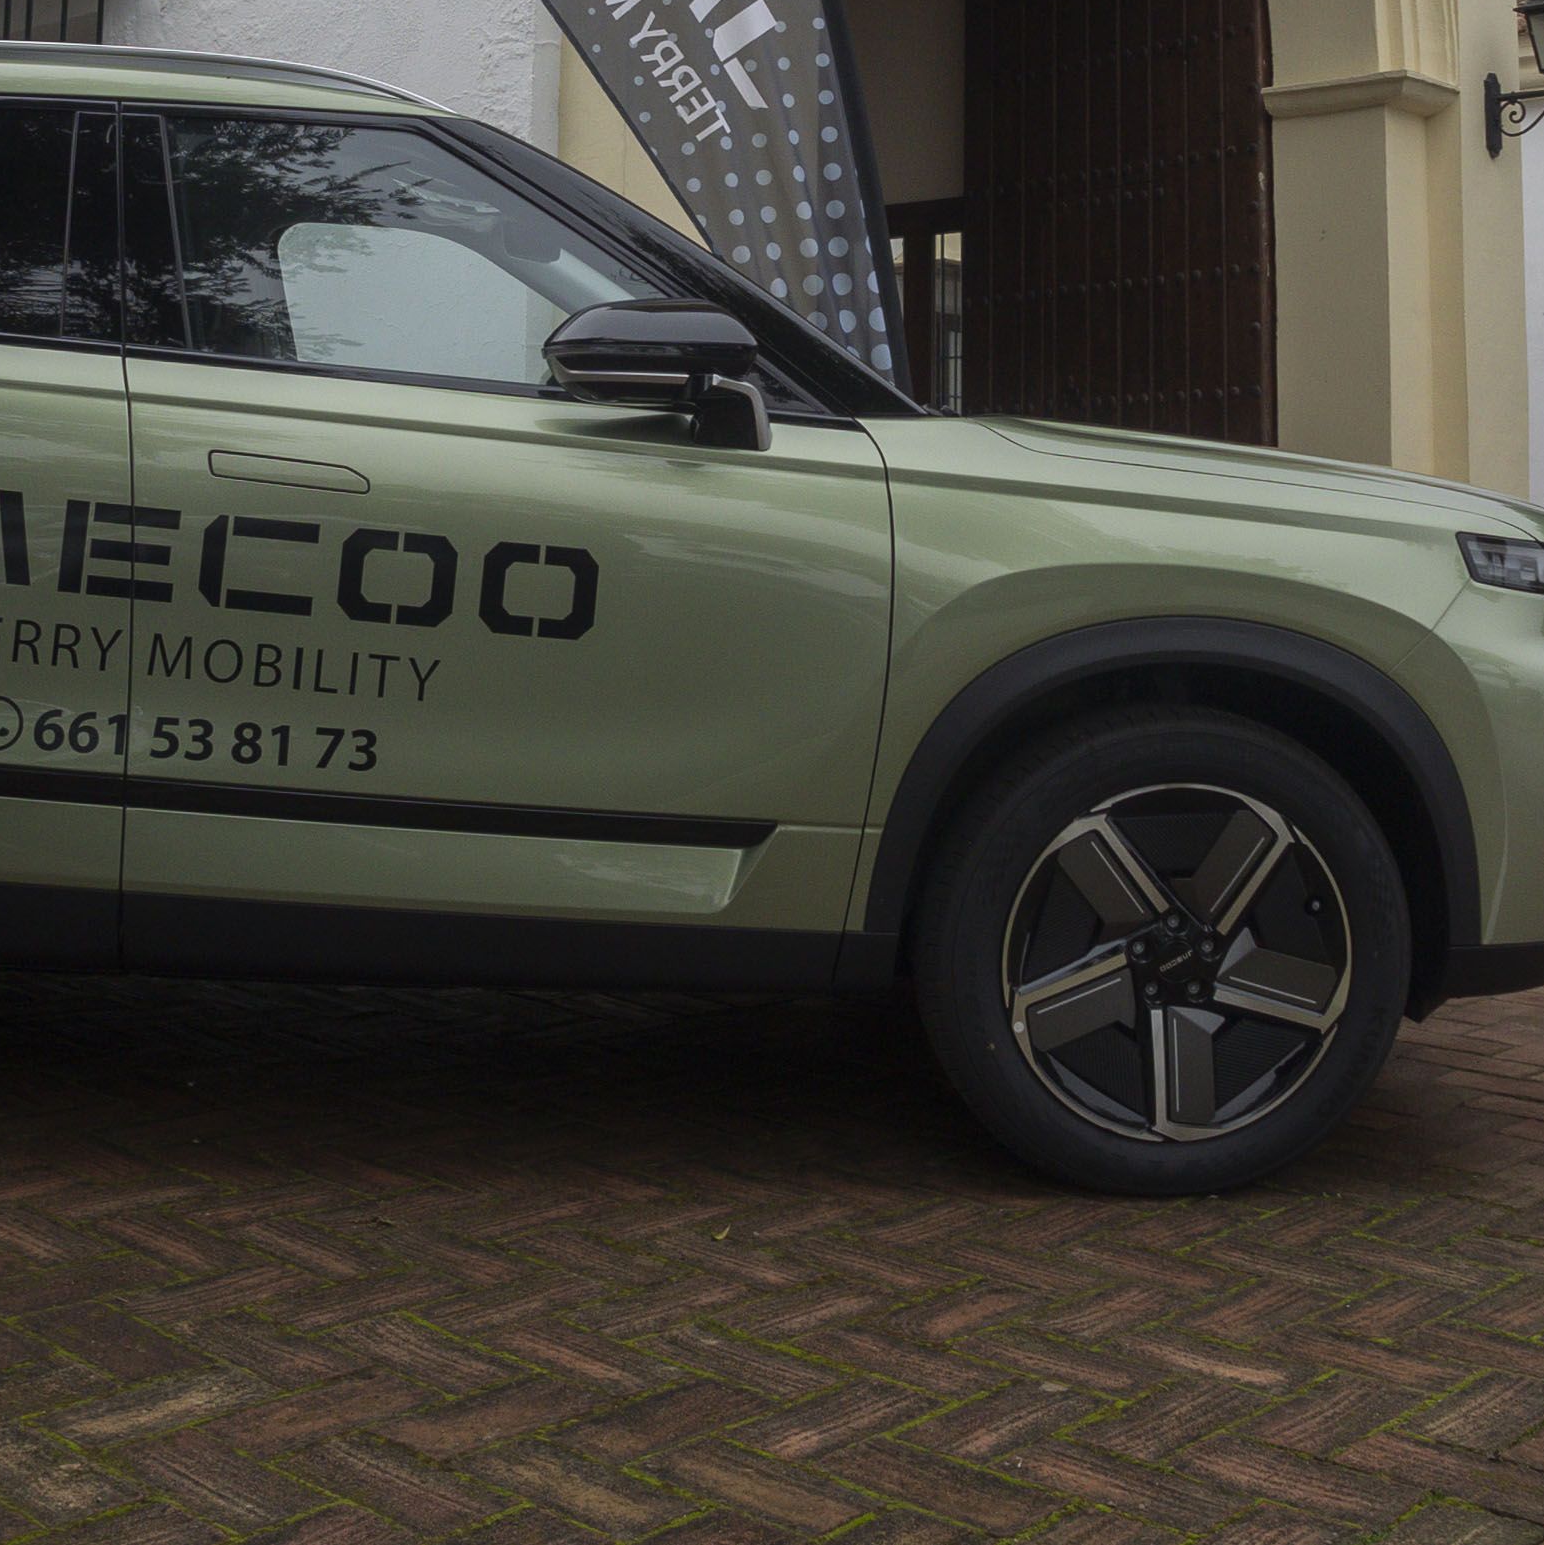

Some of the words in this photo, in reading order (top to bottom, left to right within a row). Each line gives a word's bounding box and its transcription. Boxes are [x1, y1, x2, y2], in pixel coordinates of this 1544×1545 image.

[147, 633, 441, 701] MOBILITY
[33, 709, 128, 755] 661
[150, 717, 214, 760] 53
[231, 722, 291, 766] 81
[314, 727, 378, 771] 73
